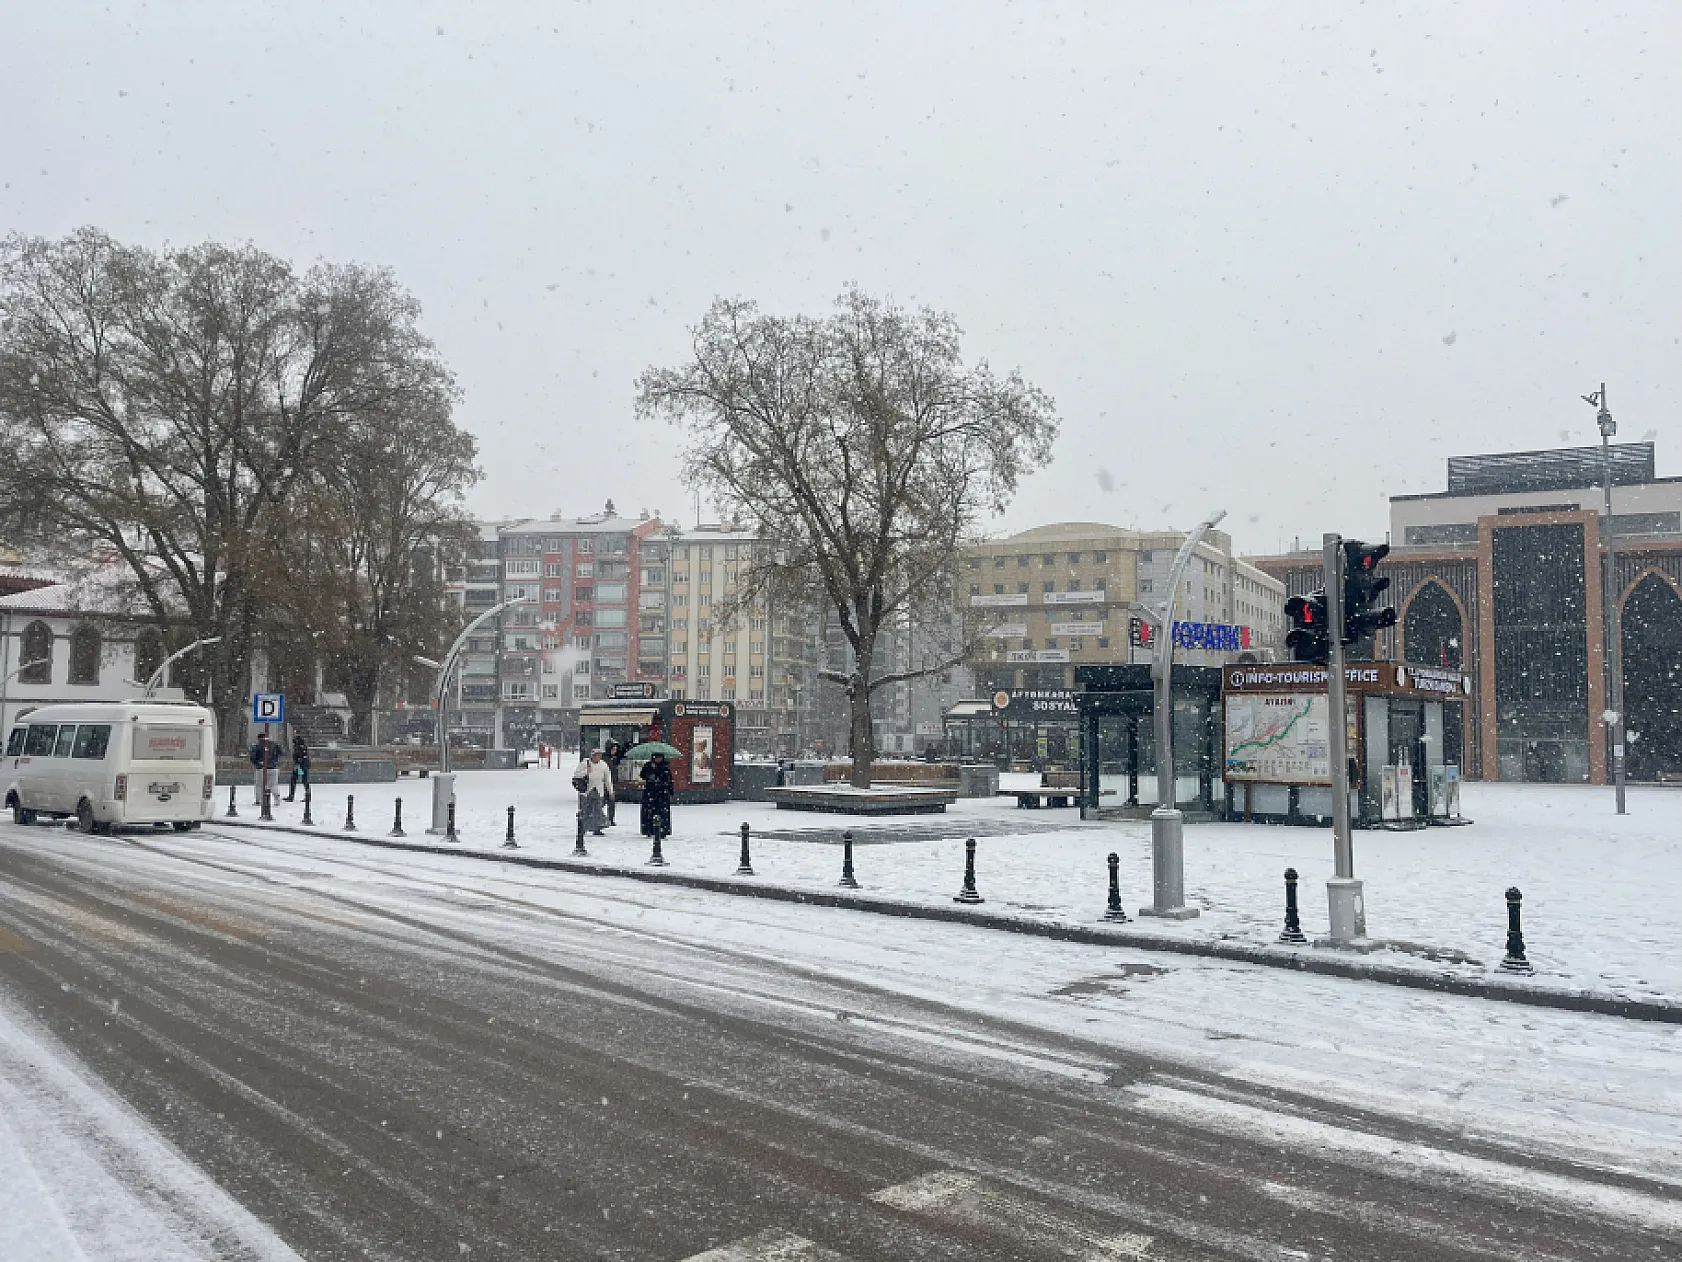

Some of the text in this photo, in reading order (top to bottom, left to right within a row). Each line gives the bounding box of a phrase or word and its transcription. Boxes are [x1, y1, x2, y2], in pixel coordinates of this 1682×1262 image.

[1171, 621, 1240, 651] TOPARK
[1344, 668, 1379, 683] FFICE
[262, 700, 275, 716] D
